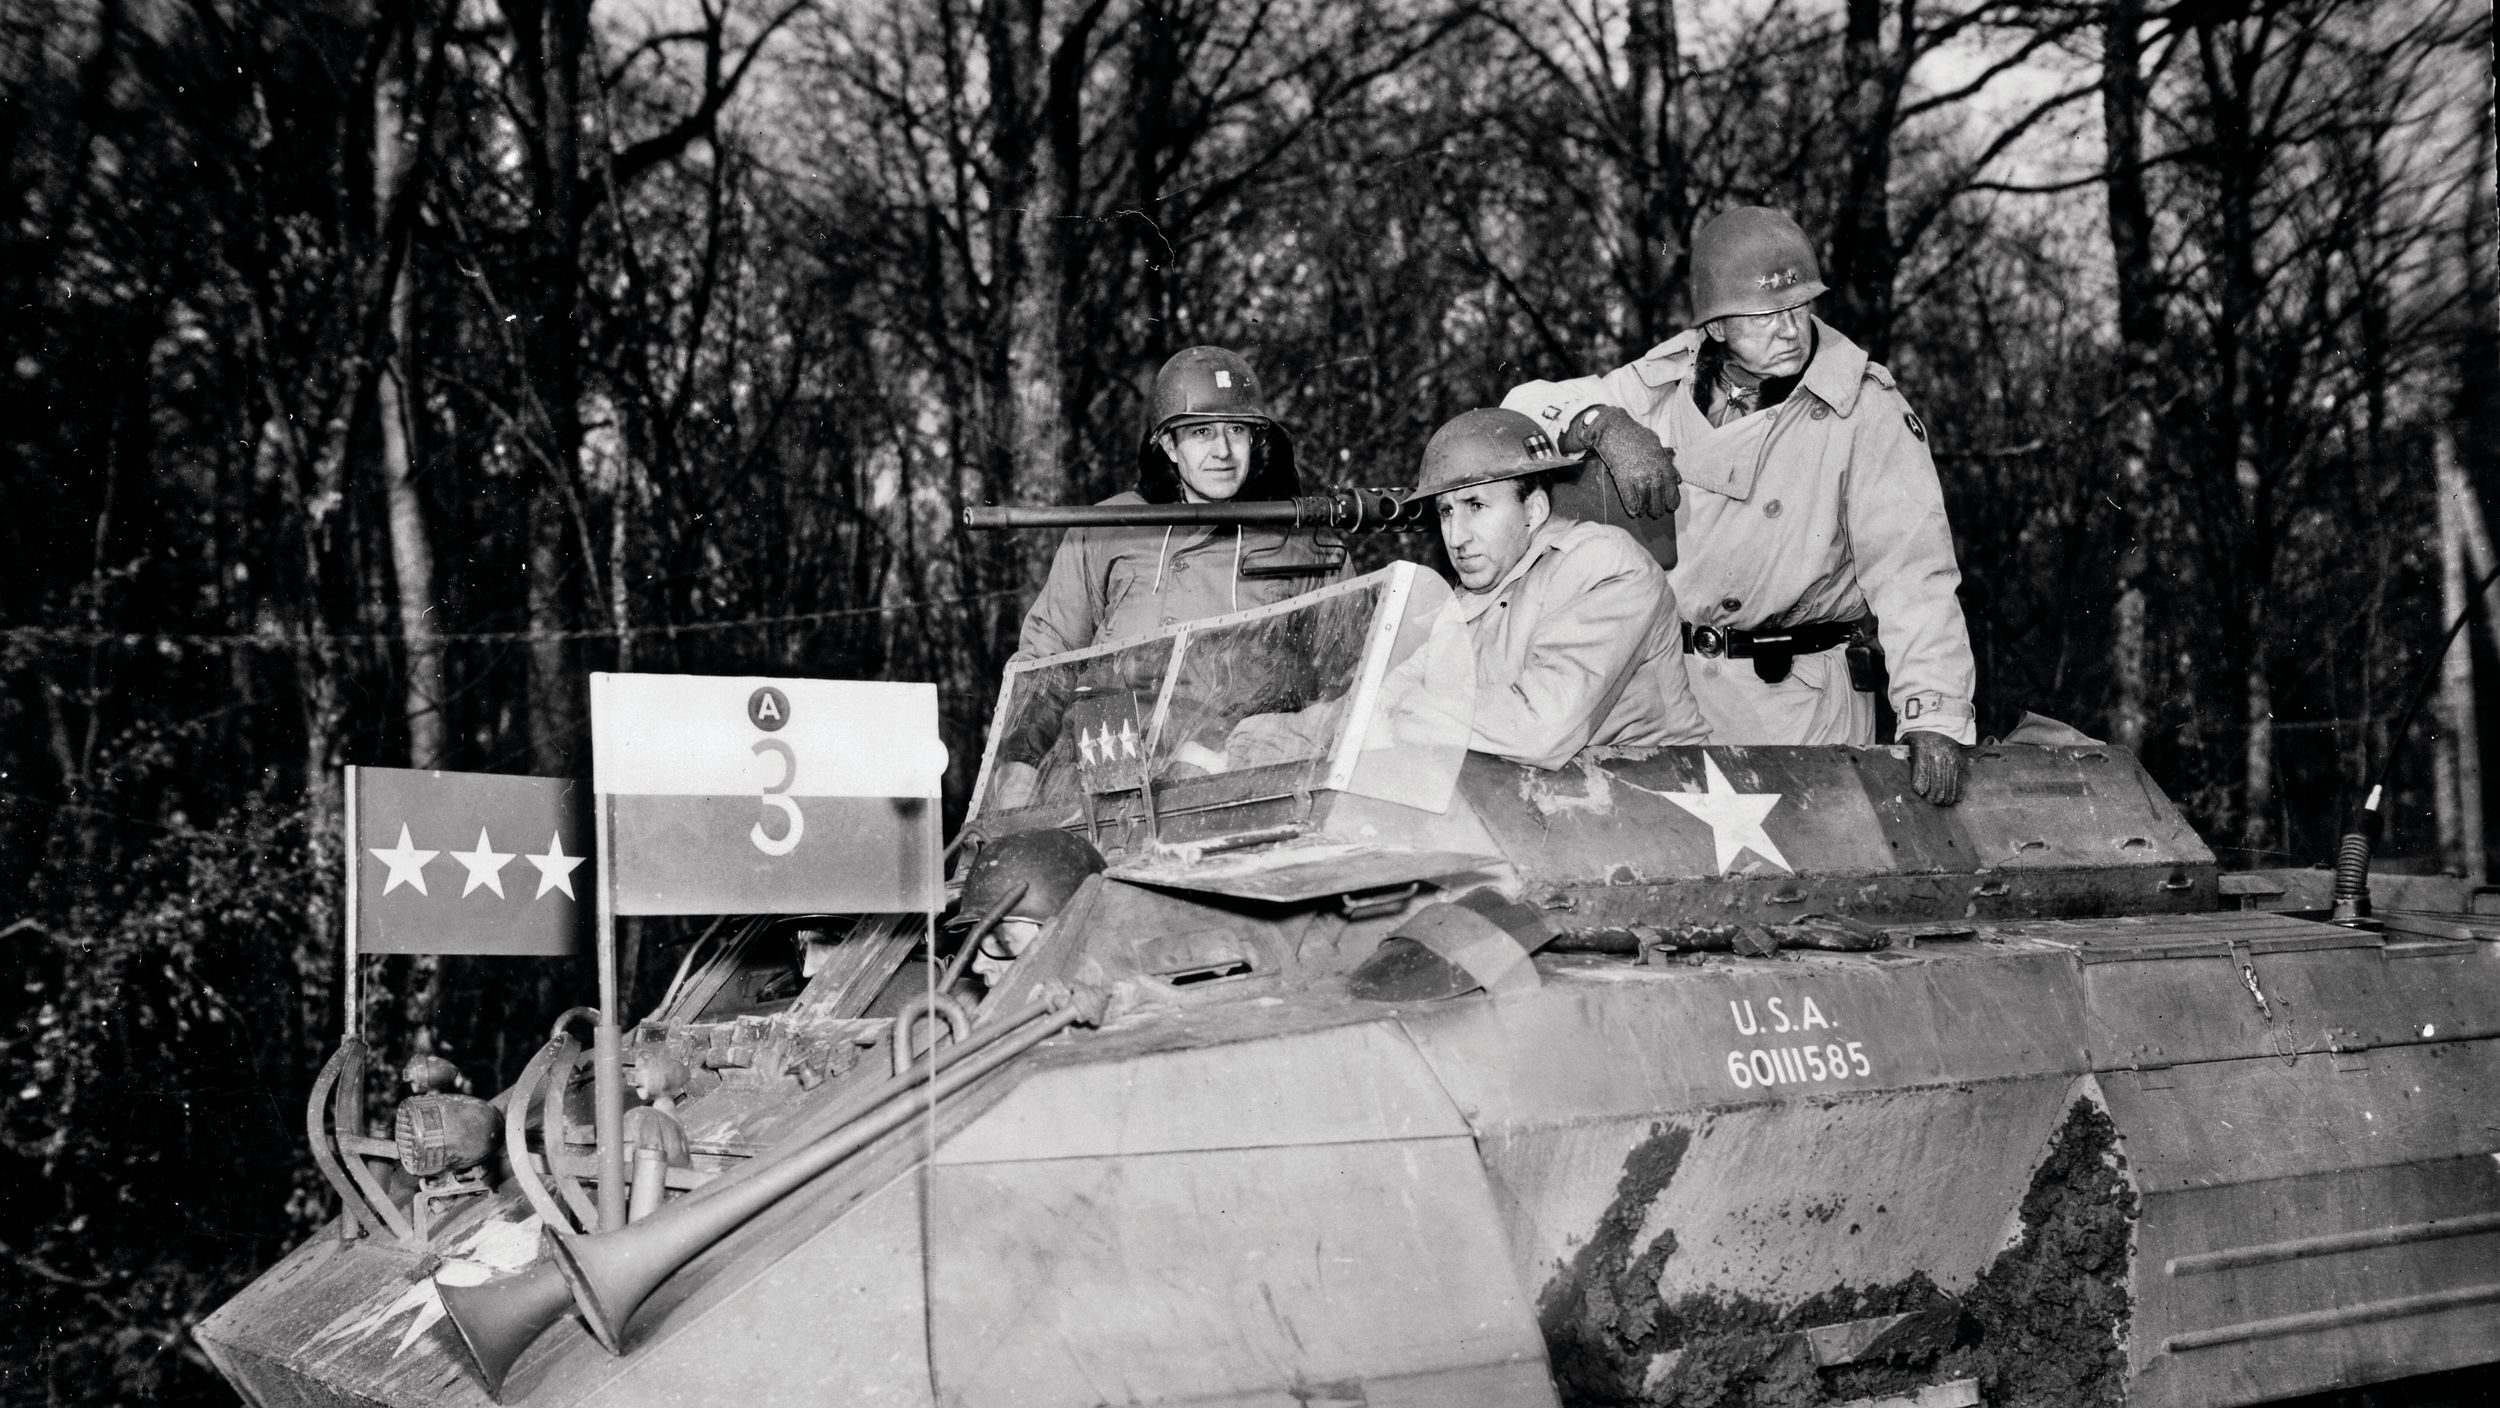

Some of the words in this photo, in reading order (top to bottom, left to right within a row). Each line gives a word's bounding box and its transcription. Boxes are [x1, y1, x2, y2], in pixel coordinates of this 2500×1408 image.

[1908, 415, 1921, 433] A
[758, 692, 781, 720] A
[750, 738, 804, 857] 3
[1729, 996, 1838, 1036] U.S.A.
[1727, 1042, 1871, 1089] 60111585
